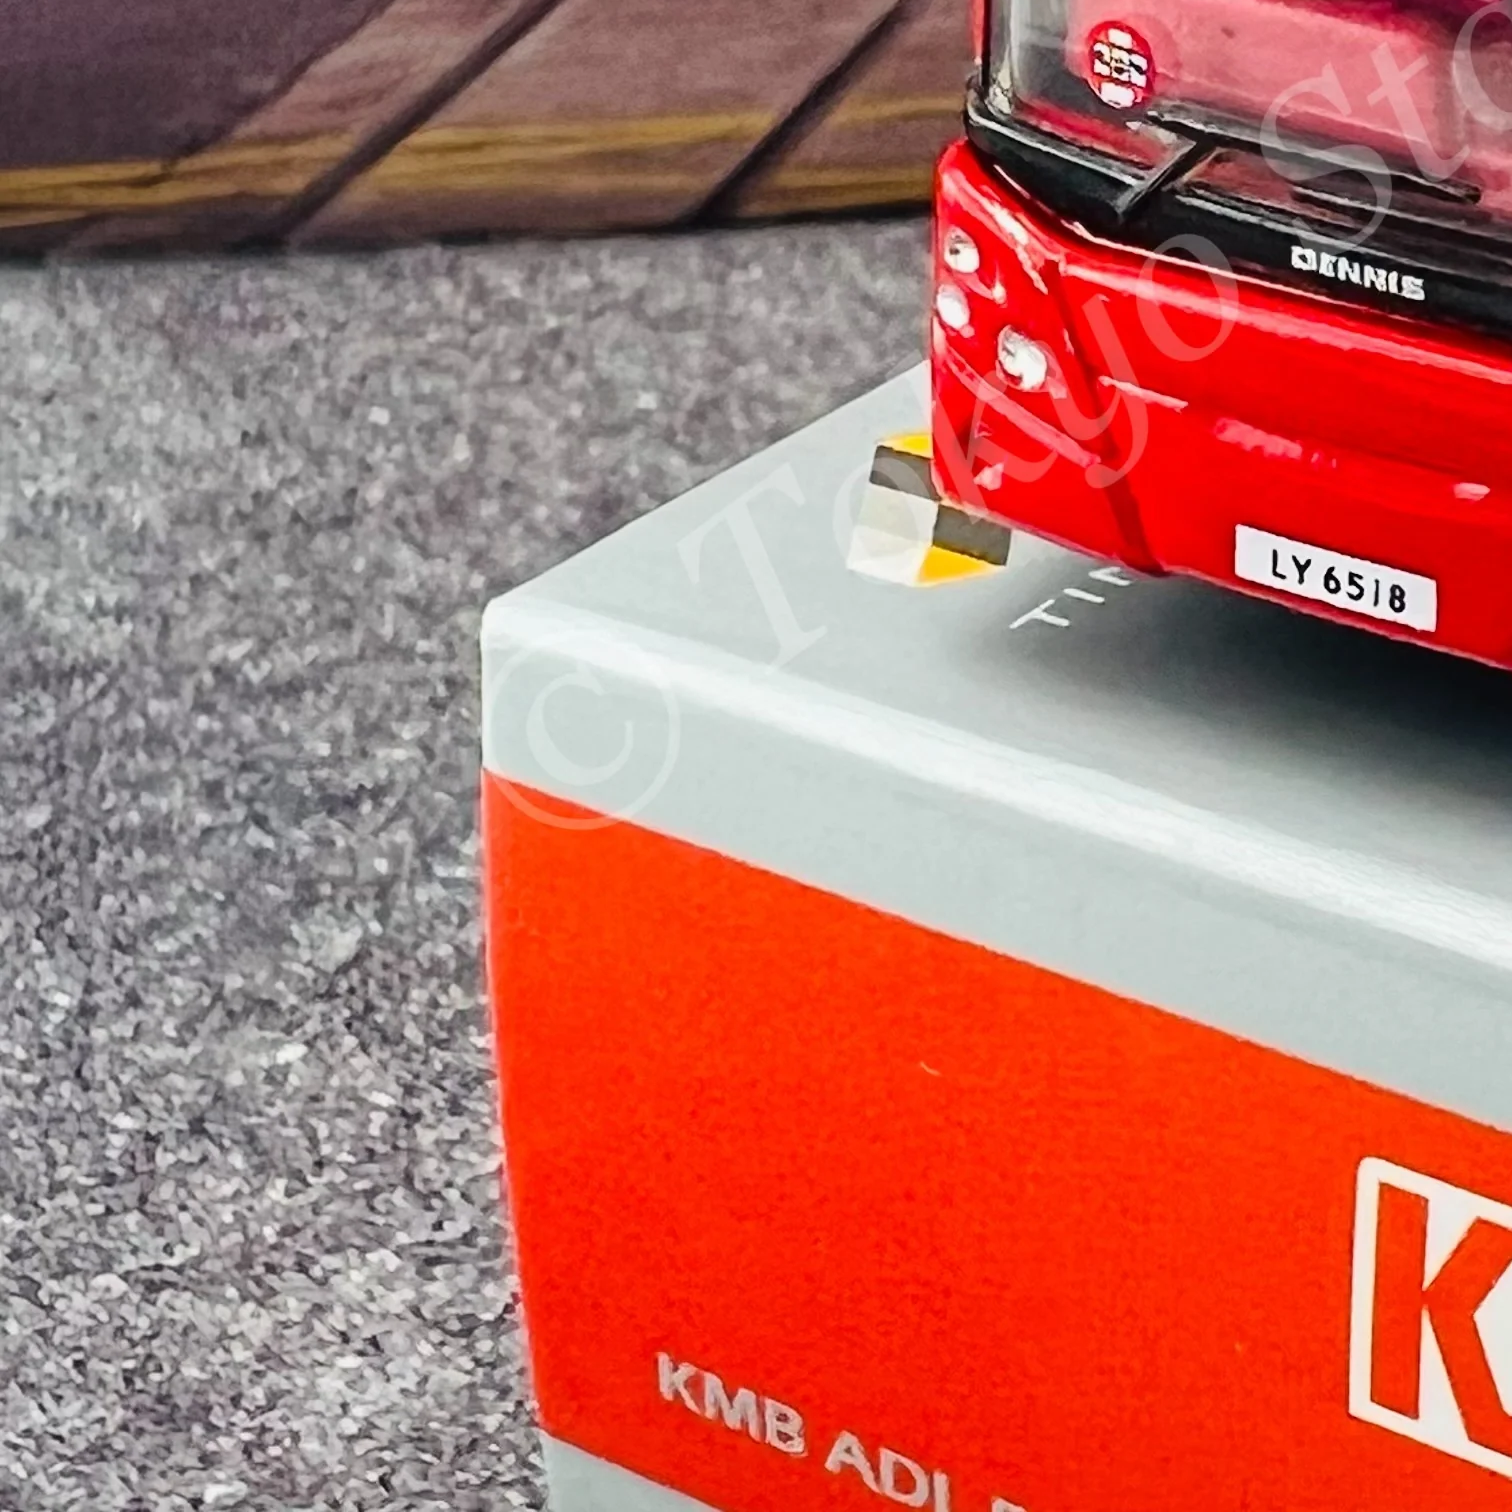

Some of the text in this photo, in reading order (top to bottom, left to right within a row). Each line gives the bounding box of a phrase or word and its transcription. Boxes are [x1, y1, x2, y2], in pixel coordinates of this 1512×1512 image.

[1290, 245, 1426, 301] DENNIS
[1272, 548, 1406, 613] LY 6518
[655, 1352, 808, 1457] KMB
